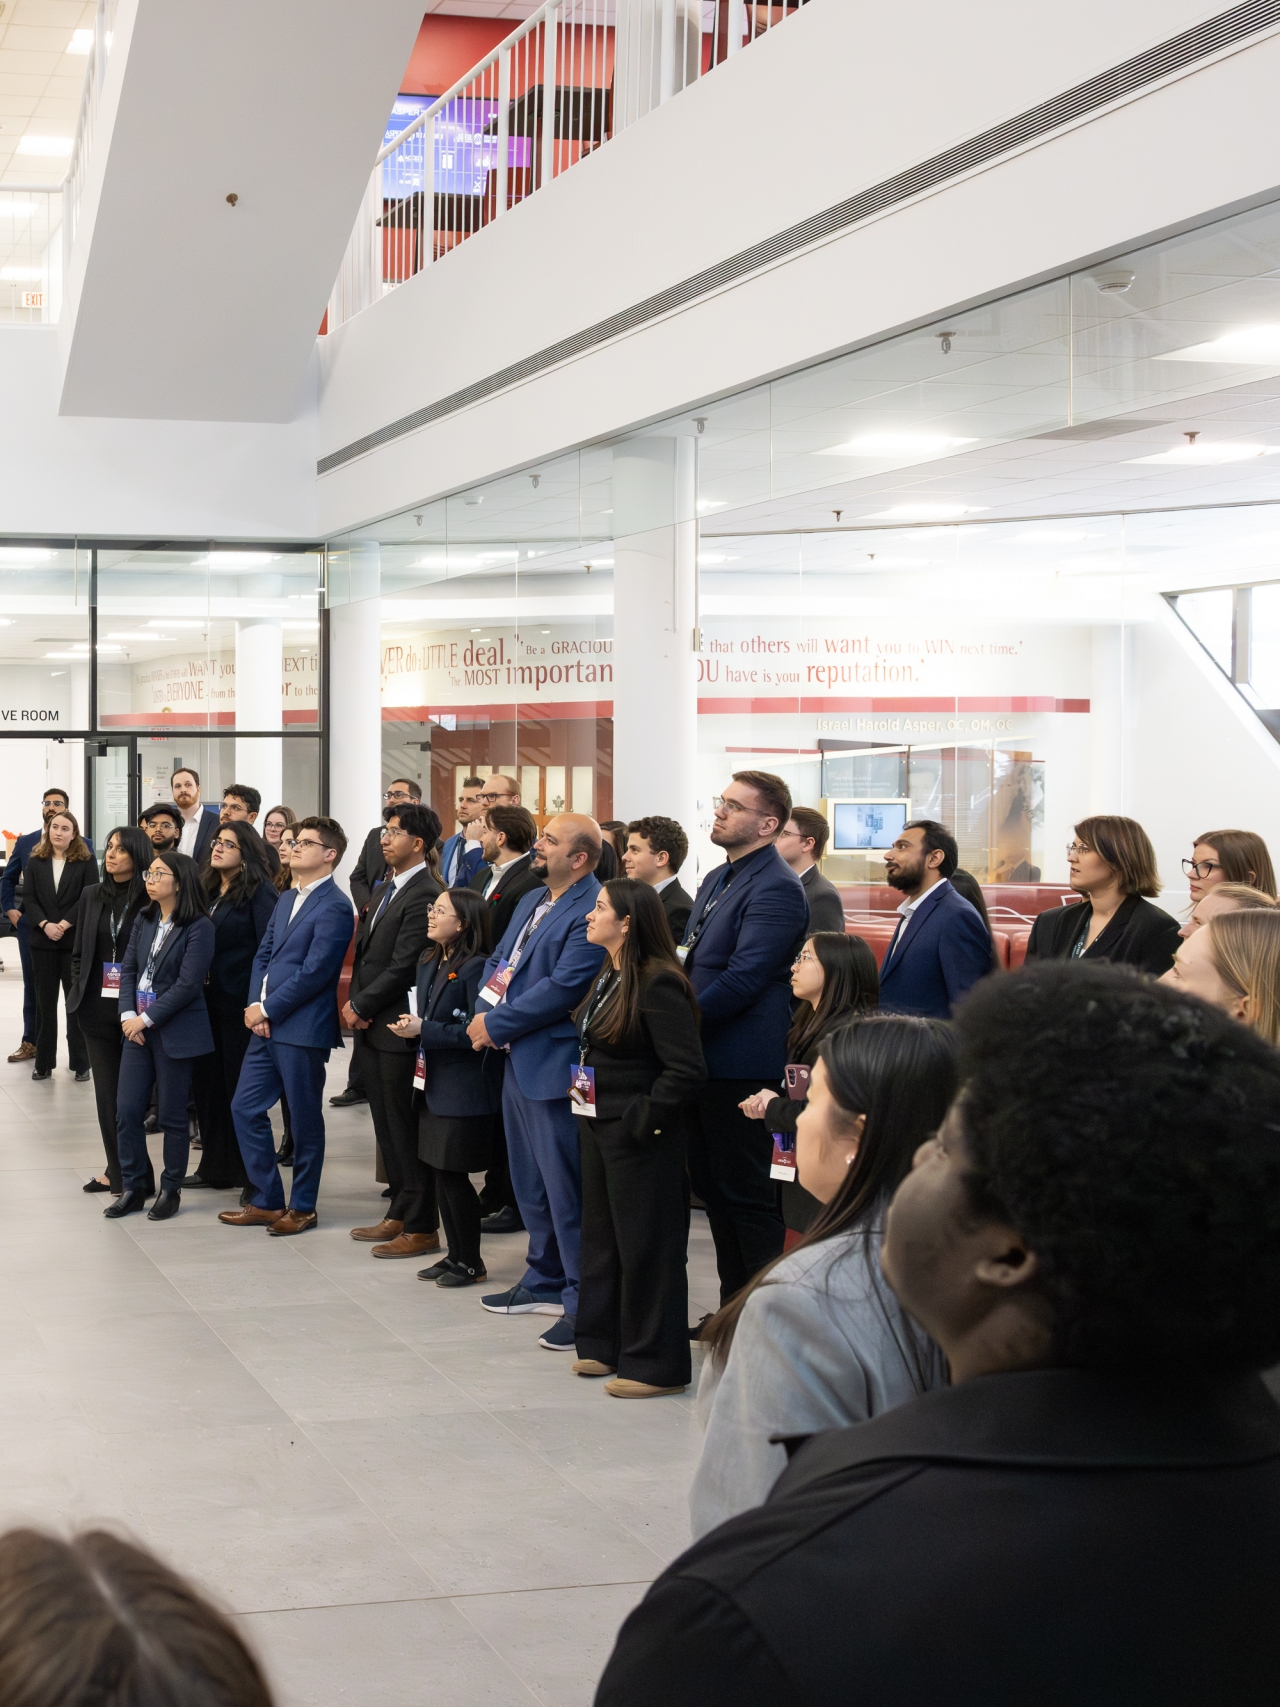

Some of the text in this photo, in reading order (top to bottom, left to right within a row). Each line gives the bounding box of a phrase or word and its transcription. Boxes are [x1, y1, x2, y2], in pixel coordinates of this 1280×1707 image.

[25, 293, 43, 306] EXIT
[540, 646, 546, 655] a
[709, 638, 734, 654] that
[740, 636, 791, 654] others
[796, 638, 818, 654] will
[824, 635, 871, 654] want
[876, 641, 902, 657] you
[907, 640, 920, 654] to
[924, 638, 955, 655] WIN
[959, 642, 985, 655] next
[406, 645, 417, 672] do
[423, 642, 459, 671] LITTLE
[188, 659, 217, 677] WANT
[463, 667, 501, 686] MOST
[725, 665, 759, 683] have
[763, 668, 772, 683] is
[166, 680, 204, 701] EVERYONE
[210, 687, 226, 699] from
[294, 686, 303, 697] to
[21, 710, 60, 722] ROOM
[816, 717, 1014, 734] Israel Harold Asper, OC, OM, QC
